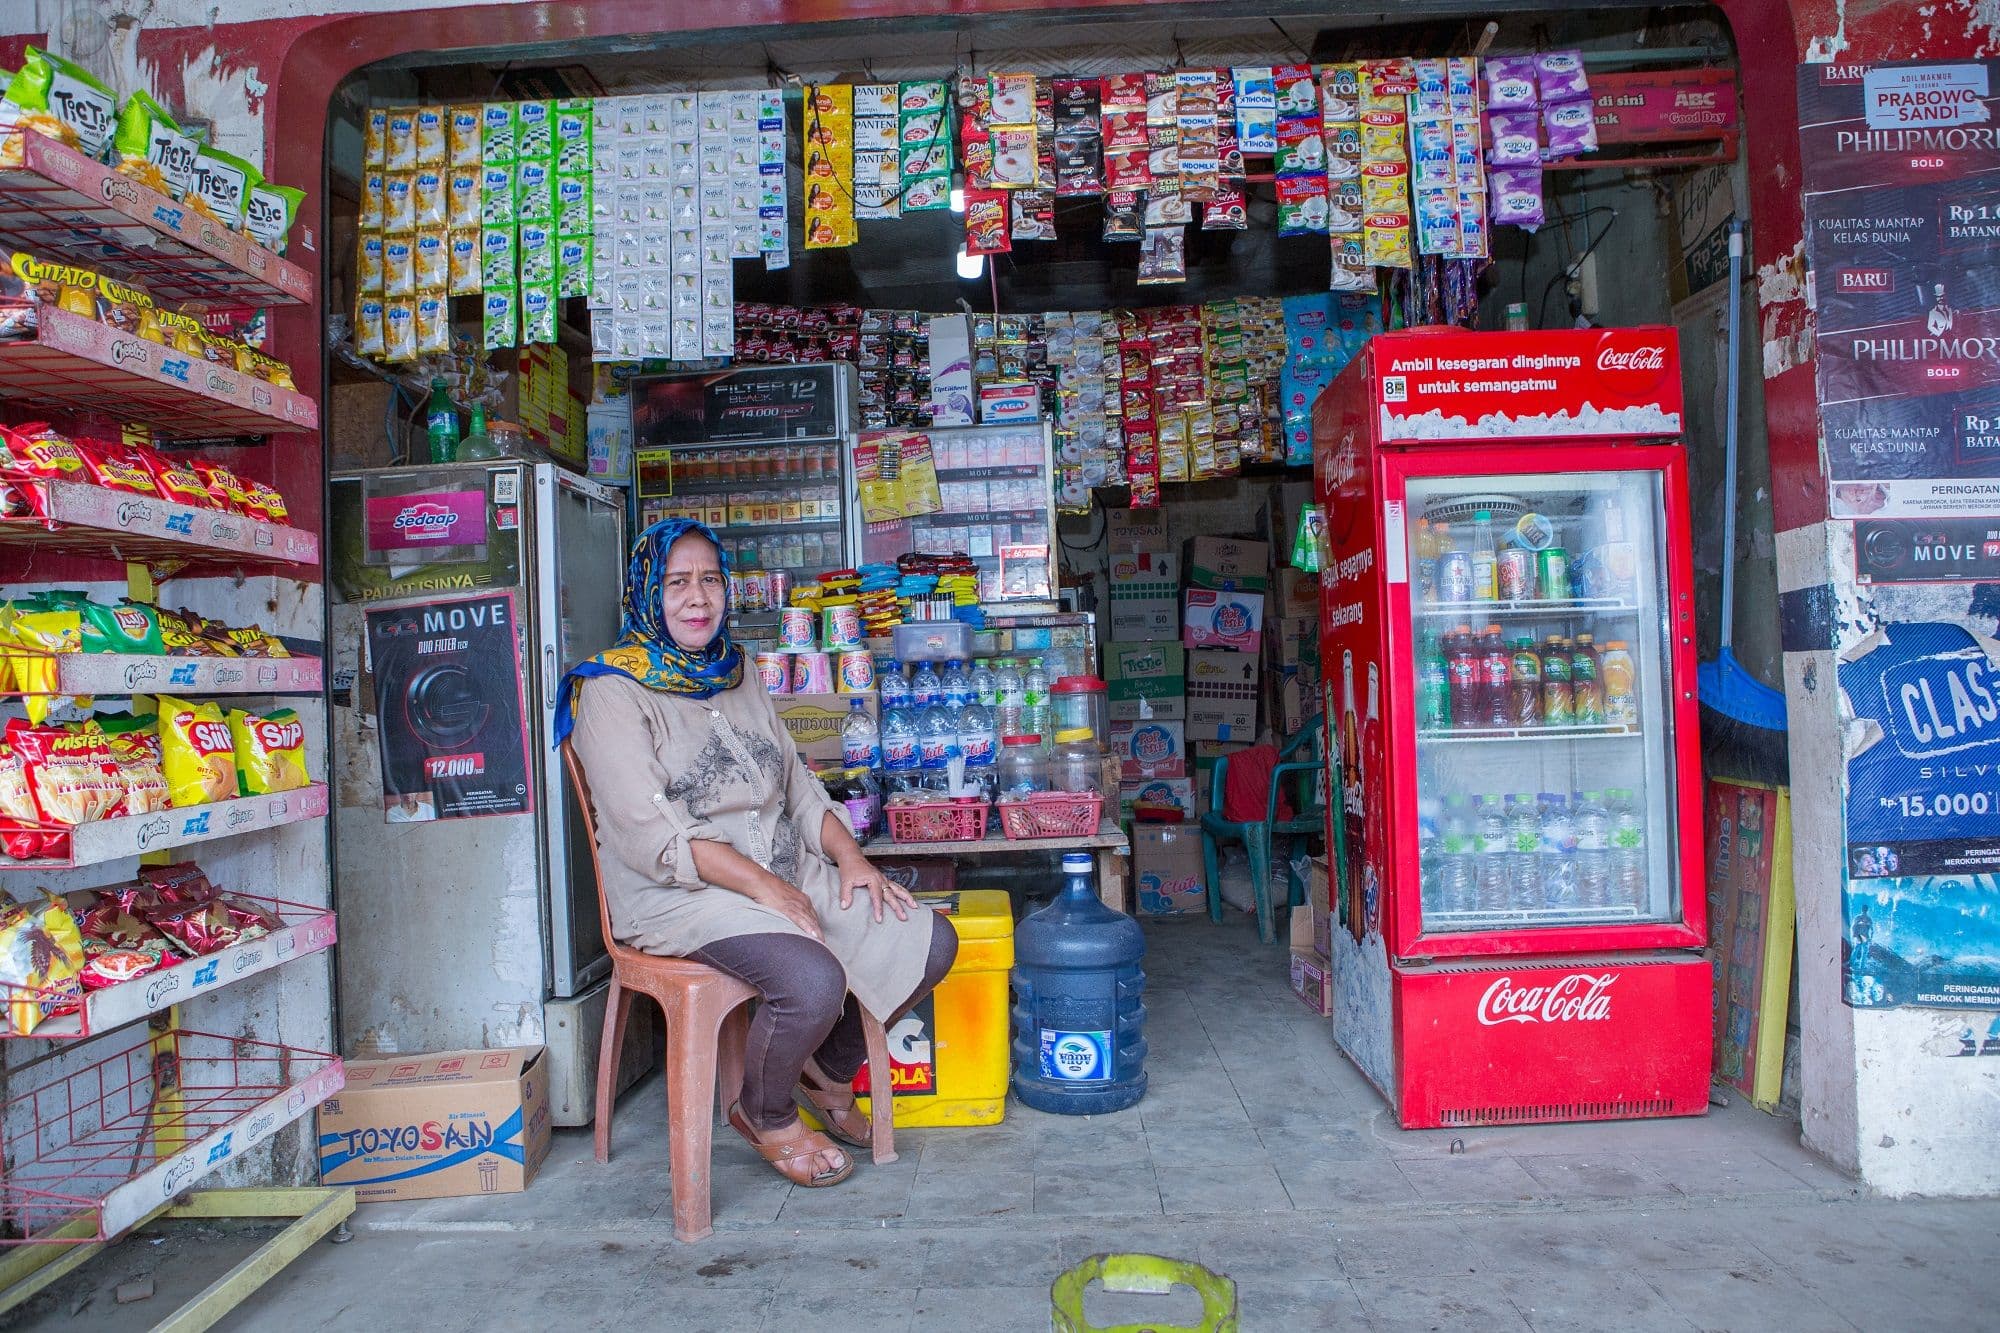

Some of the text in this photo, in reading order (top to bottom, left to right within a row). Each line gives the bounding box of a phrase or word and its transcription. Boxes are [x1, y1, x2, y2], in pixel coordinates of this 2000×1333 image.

[1546, 58, 1575, 66] Protex
[1921, 73, 1951, 81] MAKMUR
[1599, 94, 1644, 106] di sini
[1675, 92, 1716, 107] ABC
[1878, 90, 1976, 107] PRABOWO
[1372, 114, 1391, 122] SUN
[1556, 111, 1585, 121] Protex
[1669, 111, 1726, 124] Good Day
[1899, 106, 1958, 121] SANDI
[855, 154, 899, 163] PANTENE
[1421, 150, 1448, 161] Klin
[1374, 165, 1394, 174] SUN
[1911, 159, 1944, 167] BOLD
[856, 189, 899, 199] PANTENE
[1376, 216, 1395, 225] SUN
[1950, 206, 1973, 224] Rp
[1427, 218, 1455, 229] Klin
[1819, 217, 1924, 229] KUALITAS MANTAP
[1834, 233, 1910, 243] KELAS DUNIA
[10, 252, 97, 288] CHITATO
[1843, 273, 1887, 286] BARU
[99, 276, 153, 308] CHITATO
[1391, 355, 1581, 372] Ambil kesegaran dinginnya
[1597, 347, 1665, 370] Coca-Cola
[790, 380, 817, 398] 12
[1418, 378, 1556, 394] untuk semangatmu
[1966, 416, 1989, 433] Rp
[1835, 428, 1940, 438] KUALITAS MANTAP
[1850, 442, 1926, 453] KELAS DUNIA
[393, 512, 458, 528] Sedaap
[1915, 545, 1976, 560] MOVE
[419, 574, 474, 592] ISINYA
[424, 604, 505, 633] MOVE
[1155, 615, 1167, 624] 60
[1332, 601, 1363, 627] sekarang
[435, 638, 457, 652] FILTER
[265, 723, 303, 747] SiiP
[52, 734, 107, 752] MISTER
[885, 744, 913, 761] Club
[1944, 985, 1999, 993] PERINGATAN
[1477, 973, 1620, 1026] Coca-Cola
[1918, 994, 1963, 1002] MEROKOK
[338, 1121, 493, 1155] TOYOSAN
